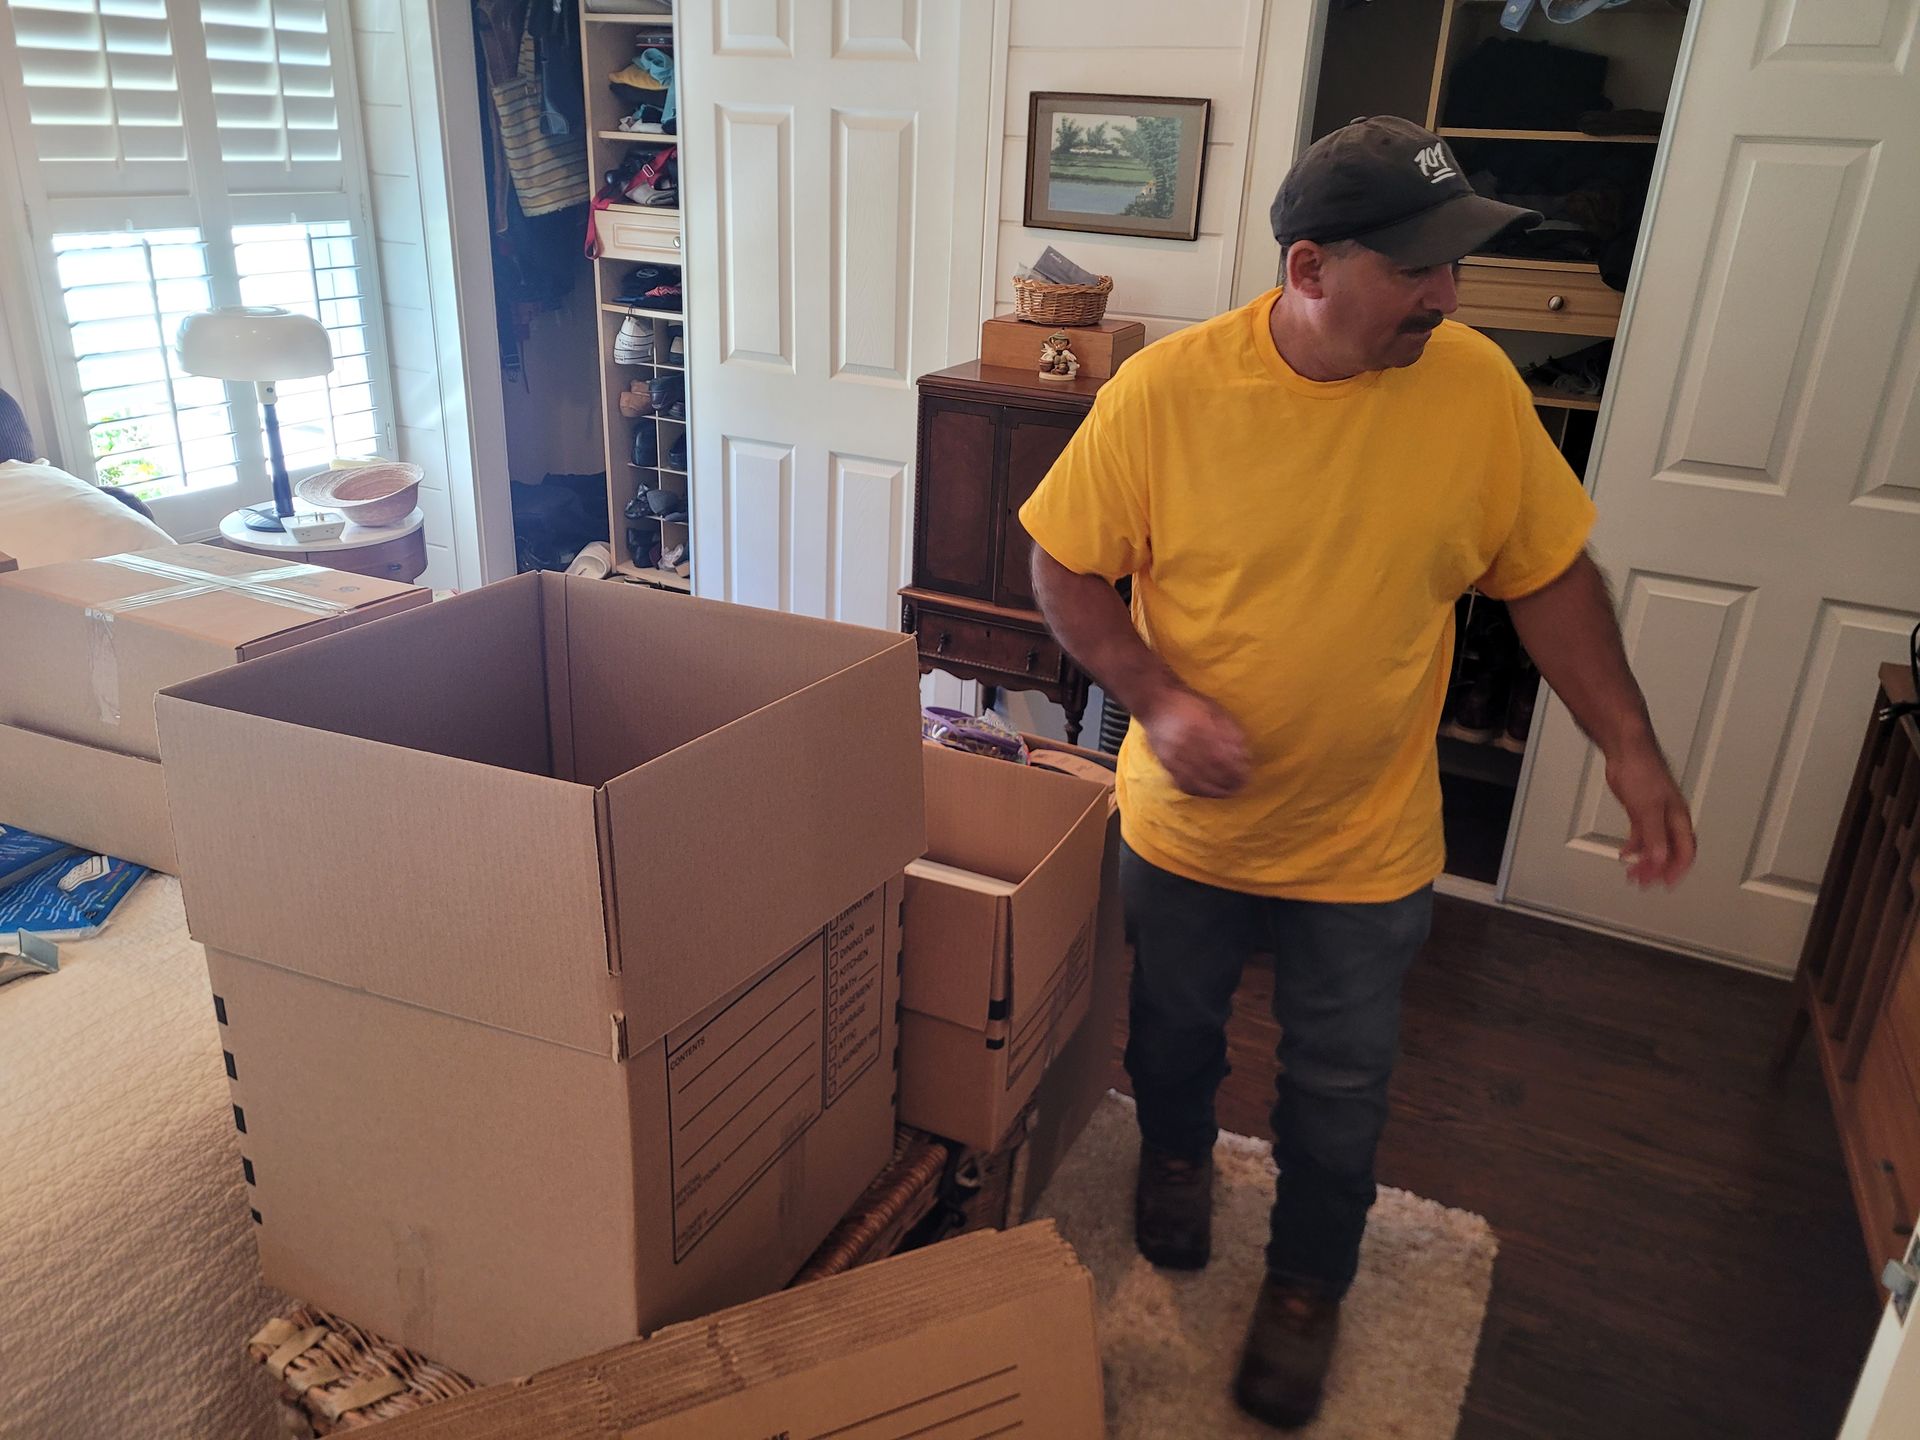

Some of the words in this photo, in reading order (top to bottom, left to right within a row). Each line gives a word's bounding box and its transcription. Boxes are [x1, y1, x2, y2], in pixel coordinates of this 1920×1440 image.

[840, 921, 854, 941] DEN
[840, 947, 869, 976] KITCHEN
[670, 1036, 705, 1070] CONTENTS
